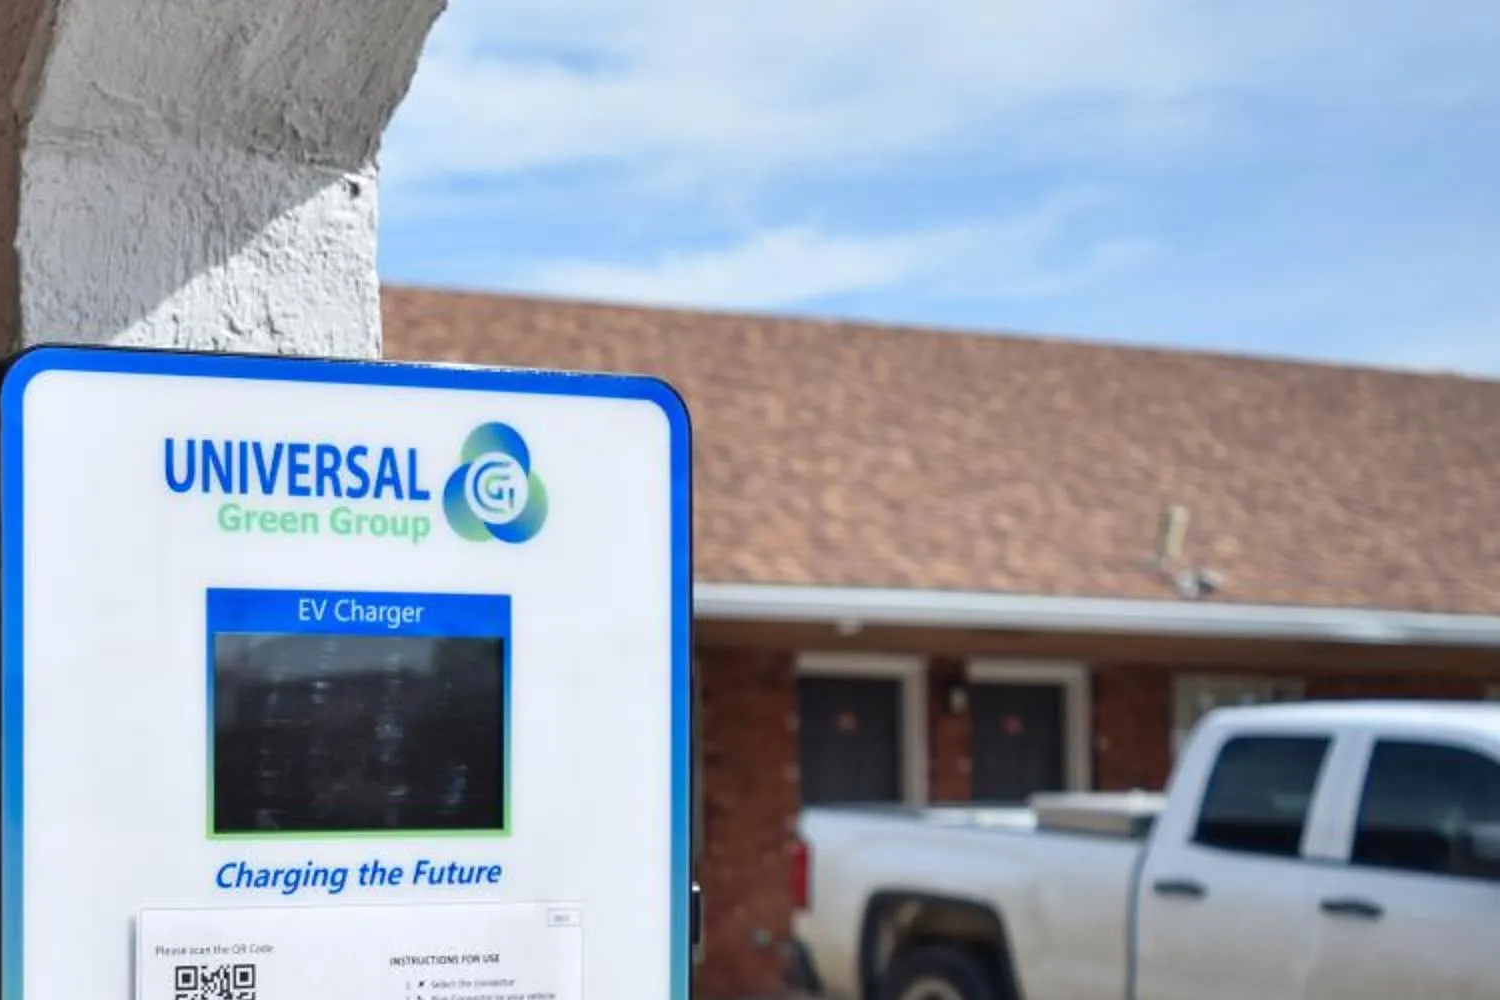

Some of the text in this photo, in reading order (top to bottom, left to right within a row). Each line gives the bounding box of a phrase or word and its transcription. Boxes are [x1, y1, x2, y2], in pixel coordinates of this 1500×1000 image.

[164, 437, 432, 501] UNIVERSAL
[217, 503, 431, 543] Green Group
[298, 599, 424, 628] EV Charger
[216, 860, 503, 894] Charging the Future
[155, 943, 275, 955] Please scan the QR Code
[390, 952, 500, 966] INSTRUCTIONS FOR USE
